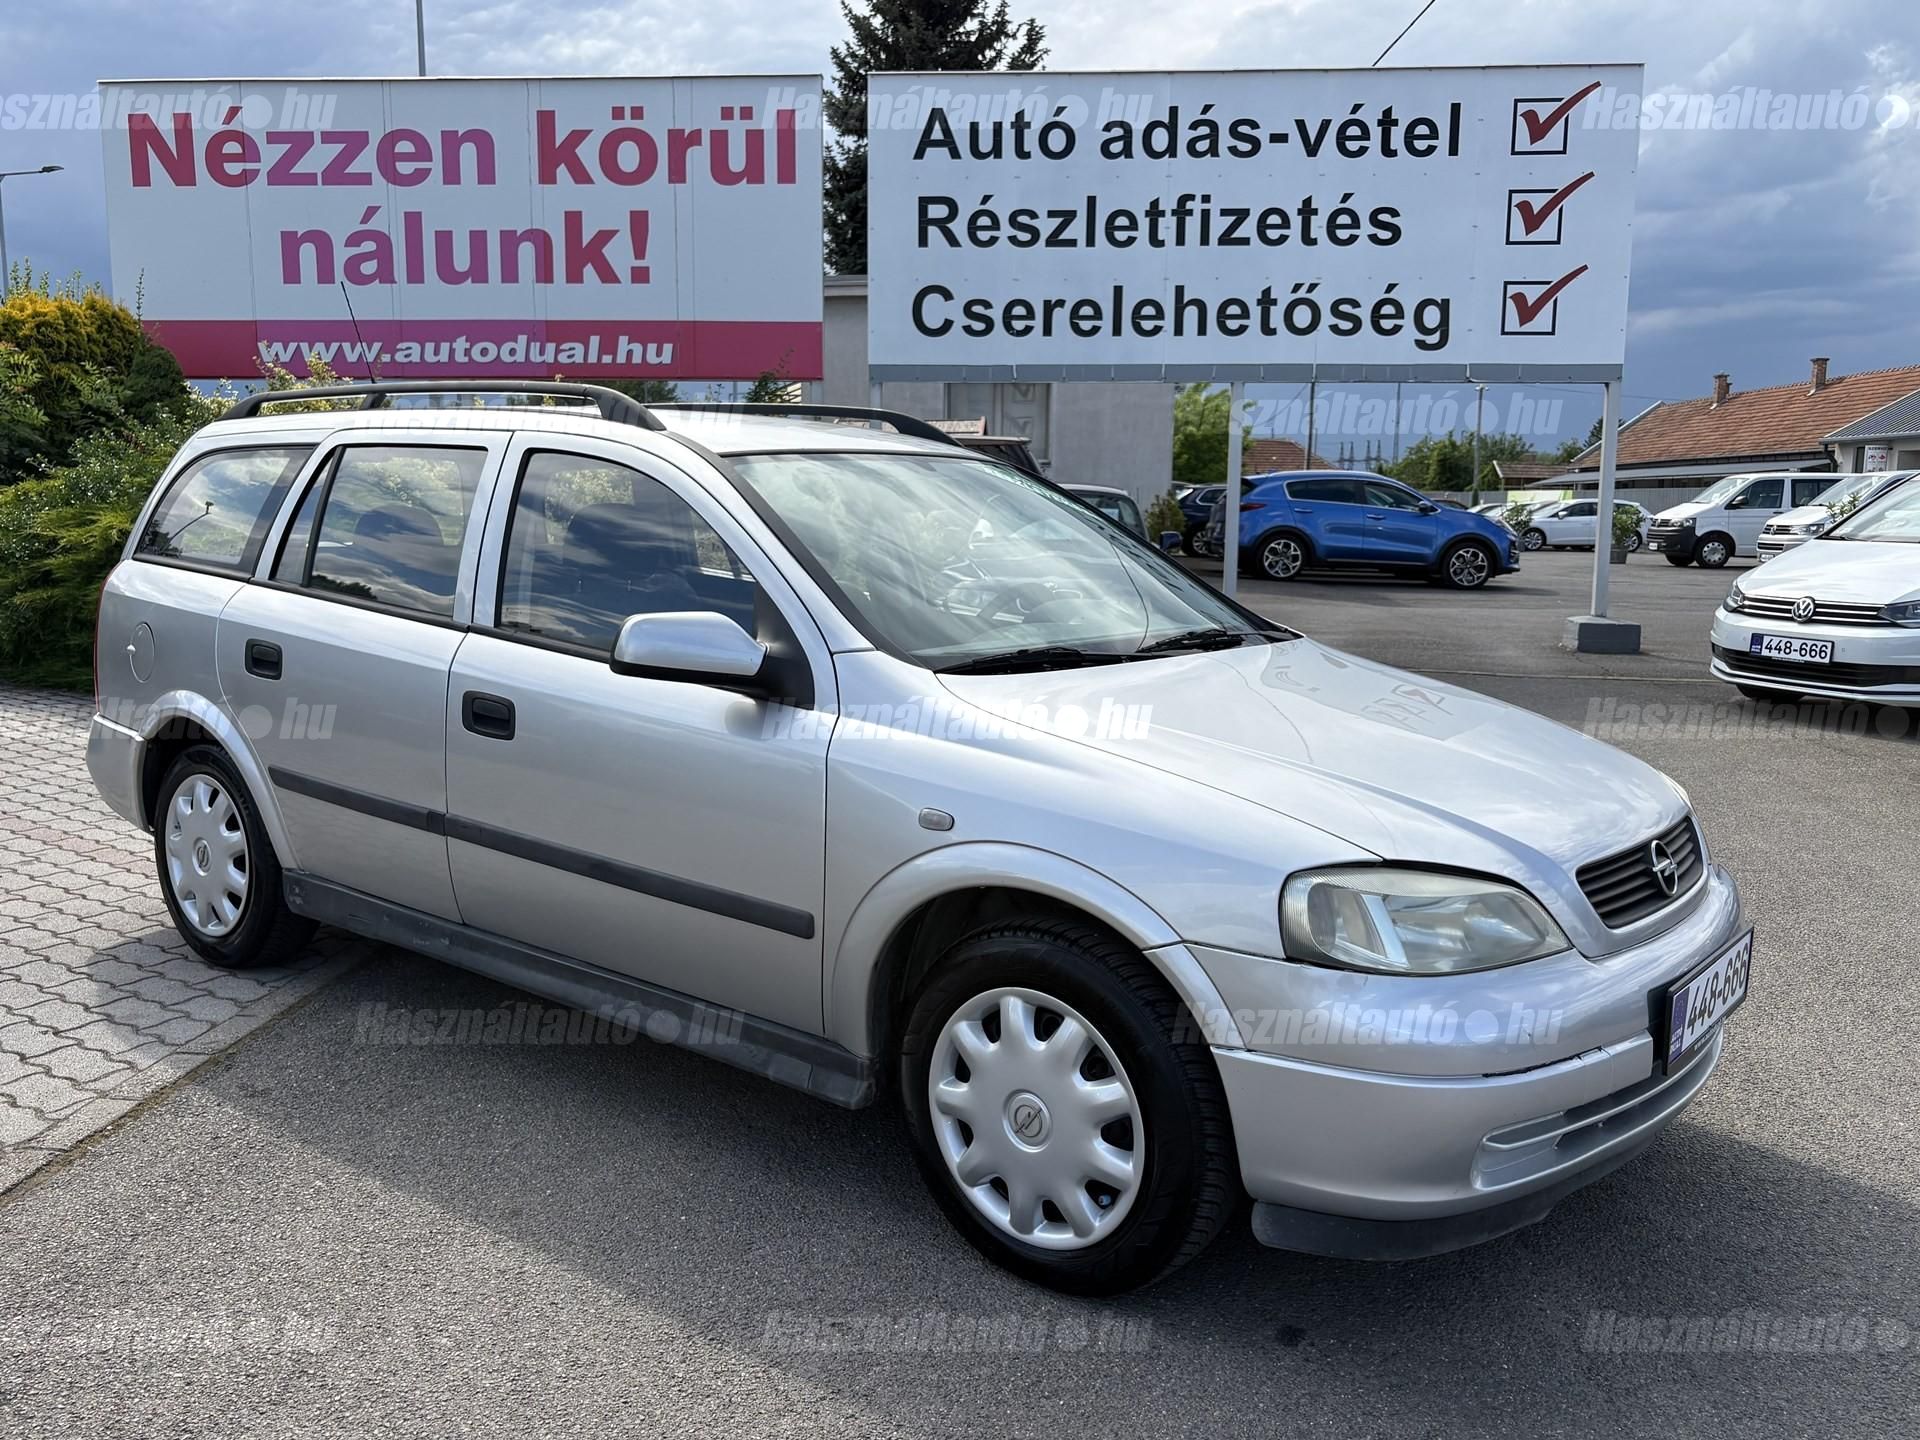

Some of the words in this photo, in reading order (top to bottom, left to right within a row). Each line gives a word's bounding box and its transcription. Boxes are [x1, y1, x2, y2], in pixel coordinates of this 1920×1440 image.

[127, 106, 497, 188] Nézzen
[537, 106, 797, 186] körül
[913, 106, 1077, 161] Autó
[1100, 102, 1462, 161] adás-vétel
[281, 206, 650, 286] nálunk!
[917, 192, 1402, 249] Részletfizetés
[911, 281, 1452, 352] Cserelehetőség
[257, 334, 674, 365] www.autodual.hu
[1764, 638, 1828, 660] 448-666
[1686, 942, 1749, 1036] 448-666
